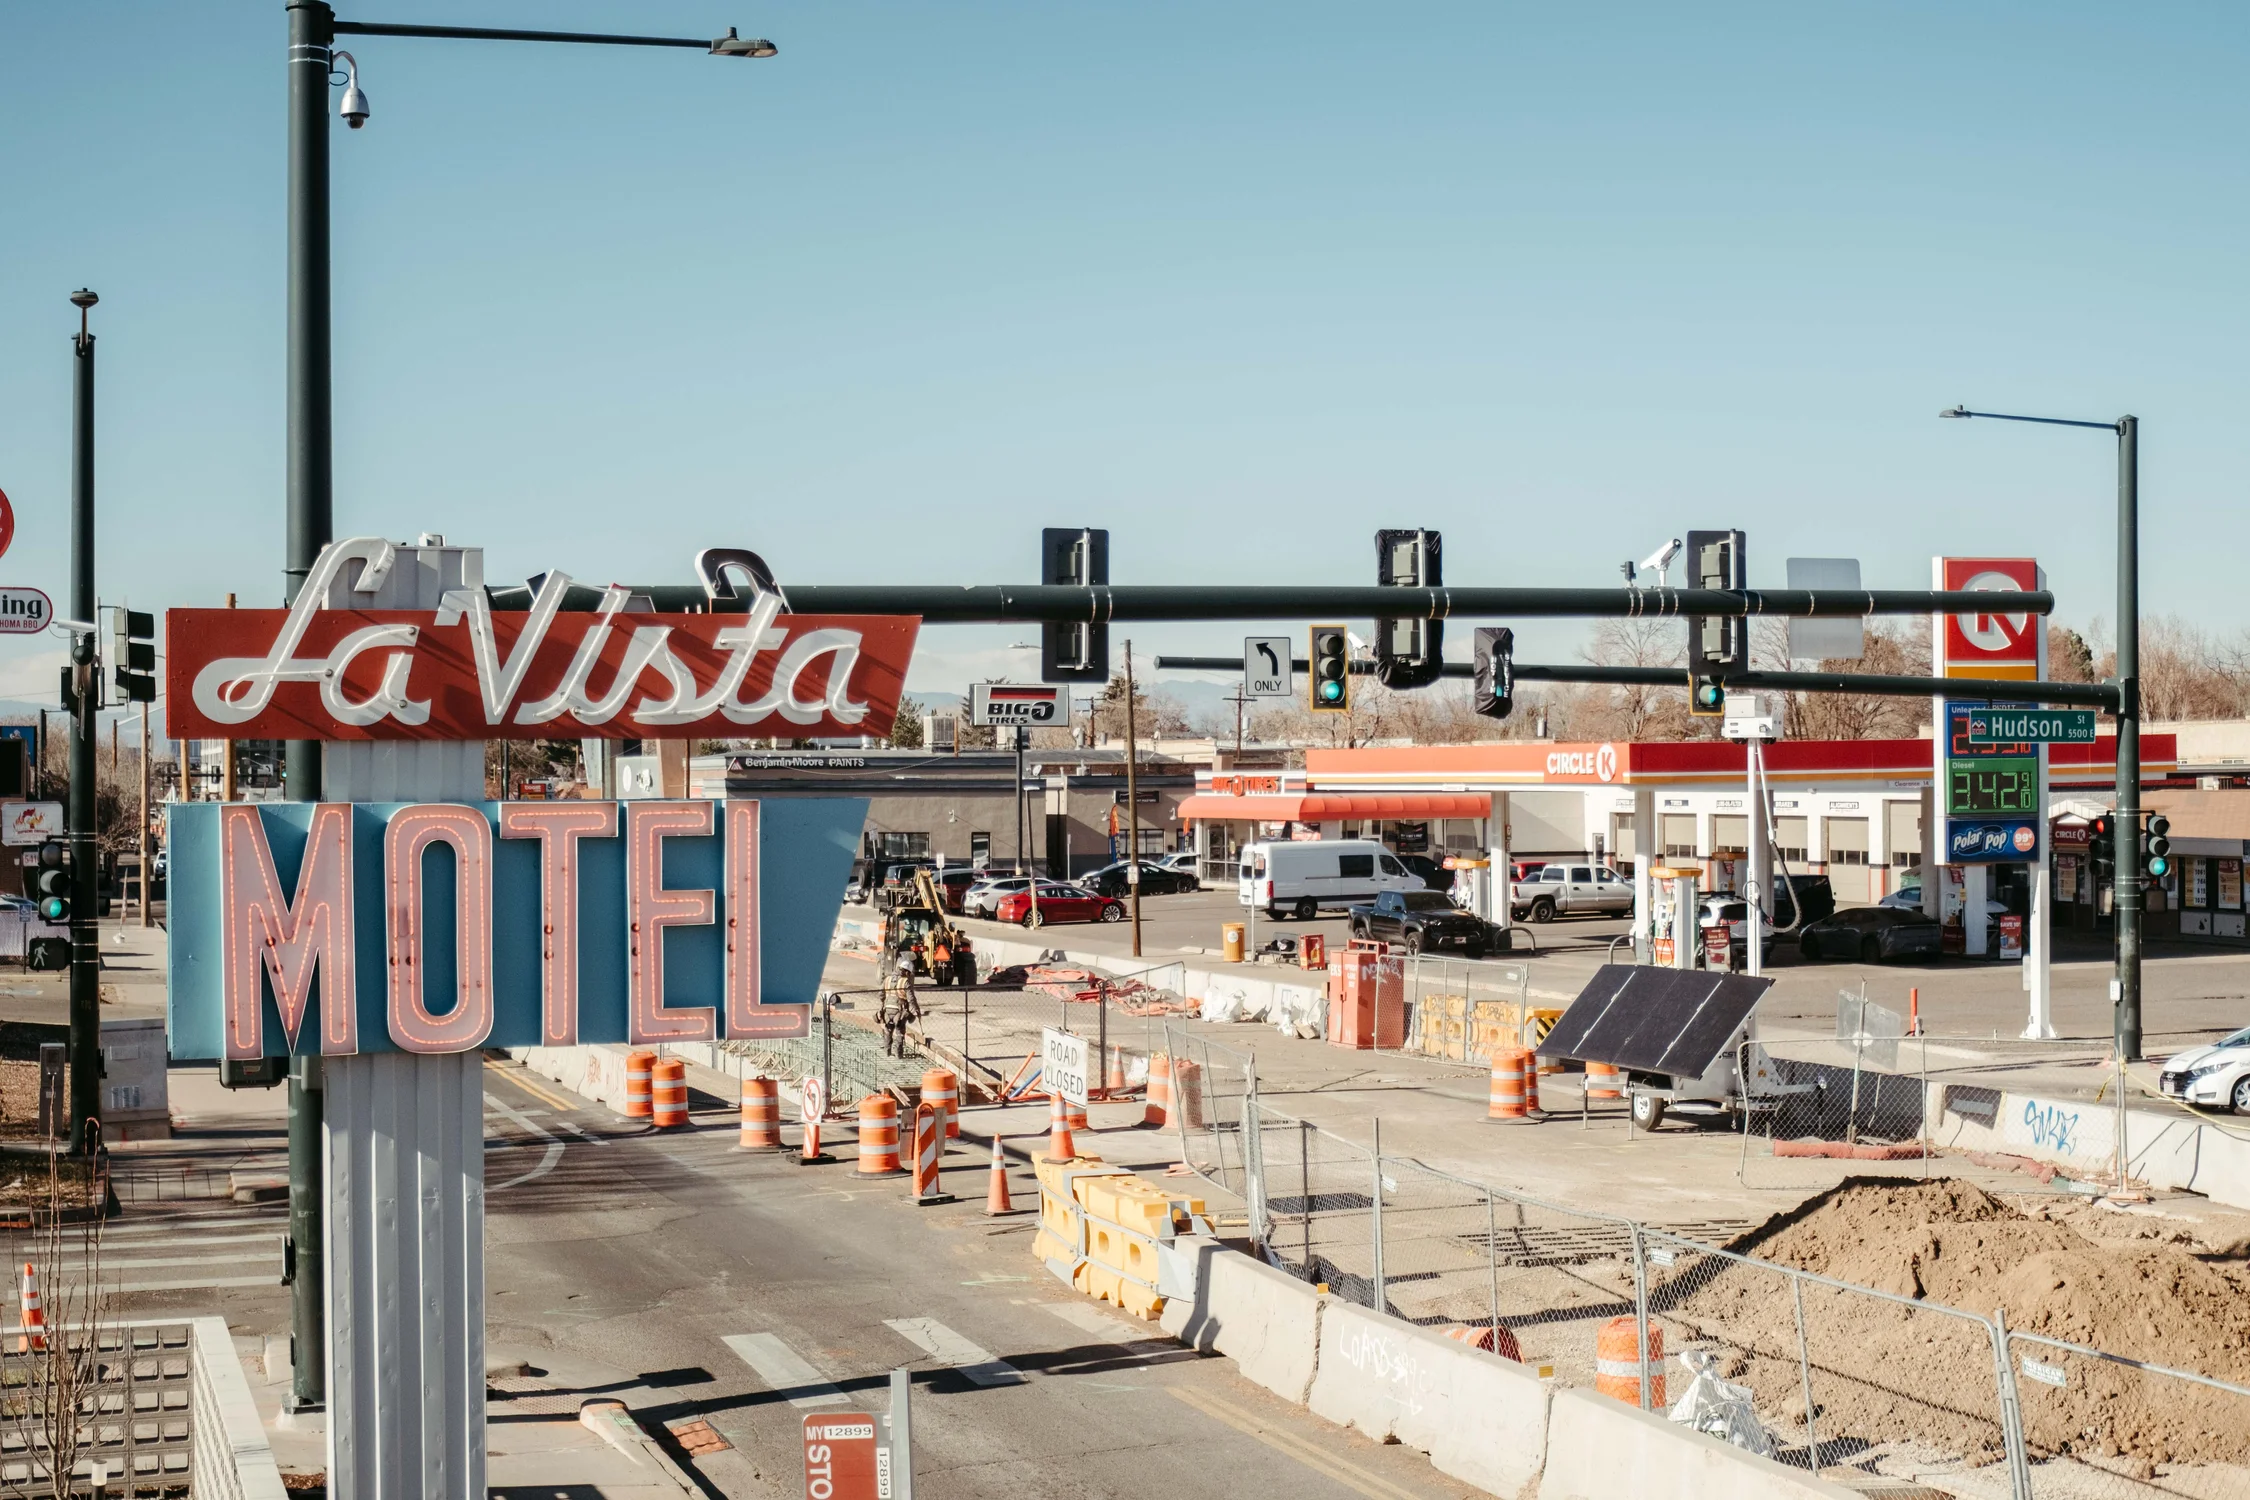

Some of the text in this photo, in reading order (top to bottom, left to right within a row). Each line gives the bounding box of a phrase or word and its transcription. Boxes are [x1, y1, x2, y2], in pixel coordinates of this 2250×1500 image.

[2, 594, 43, 619] ing
[23, 620, 38, 629] BBQ
[192, 536, 870, 725] La Vista
[1254, 680, 1282, 692] ONLY
[986, 703, 1031, 715] BIG
[986, 716, 1028, 724] TIRES
[1992, 715, 2063, 737] Hudson
[2077, 715, 2086, 725] St
[2068, 729, 2094, 738] 5500 E
[745, 757, 865, 769] Benjamin Moore PAINTS
[1547, 752, 1595, 775] CIRCLE
[1952, 761, 1975, 769] Diesel
[1211, 777, 1233, 792] BIG
[1243, 776, 1279, 792] TIRES
[1953, 830, 2008, 851] Polar Pop
[2055, 830, 2077, 839] CIRCLE
[220, 799, 812, 1060] MOTEL
[1050, 1040, 1078, 1067] ROAD
[1045, 1065, 1083, 1096] CLOSED
[806, 1426, 872, 1440] MY 12899
[808, 1444, 833, 1500] STO
[879, 1453, 889, 1496] 12899
